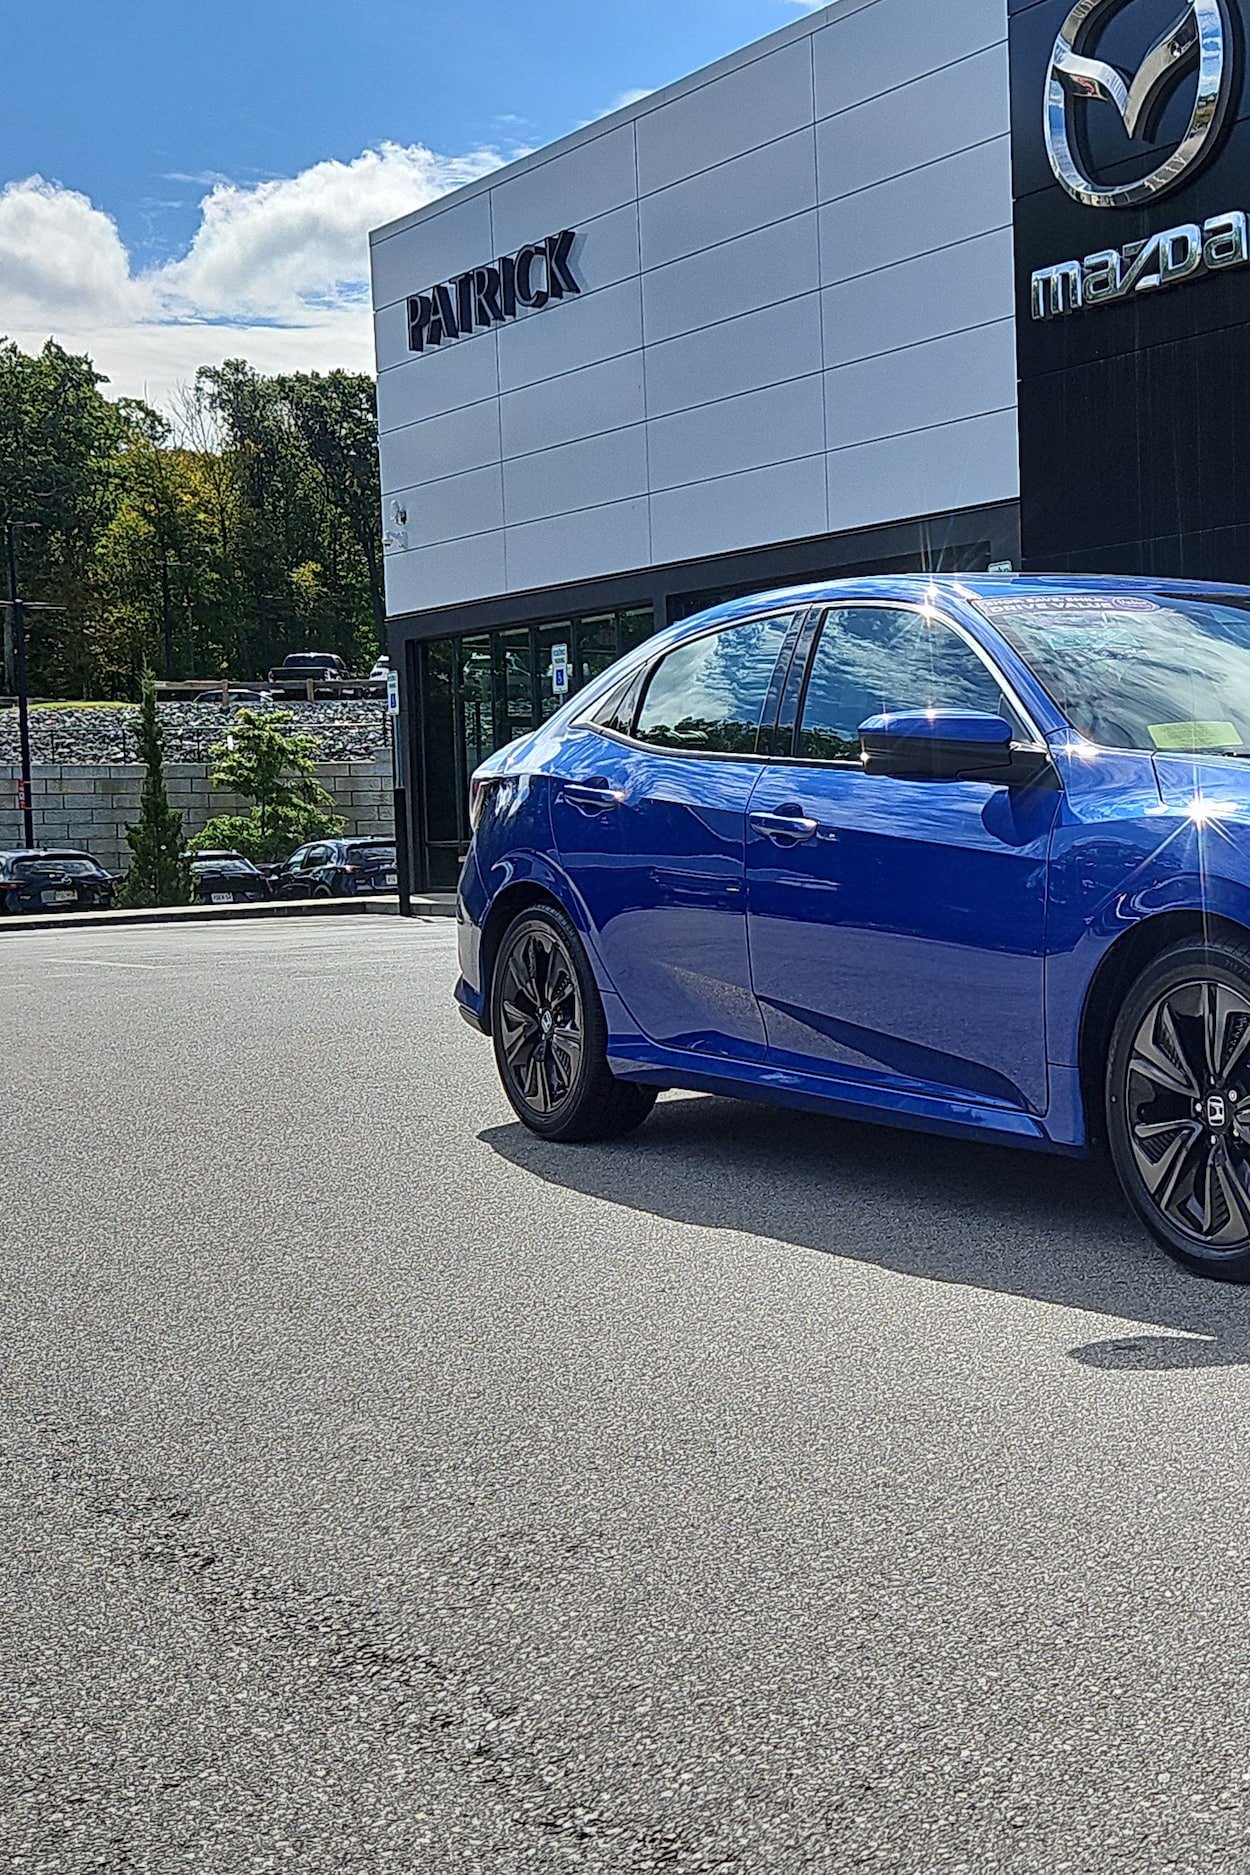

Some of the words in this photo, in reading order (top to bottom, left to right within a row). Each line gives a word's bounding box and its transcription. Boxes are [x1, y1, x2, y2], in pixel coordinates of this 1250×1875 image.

[406, 230, 581, 352] PATRICK
[989, 602, 1049, 613] DRIVE
[1050, 601, 1114, 610] VALUE
